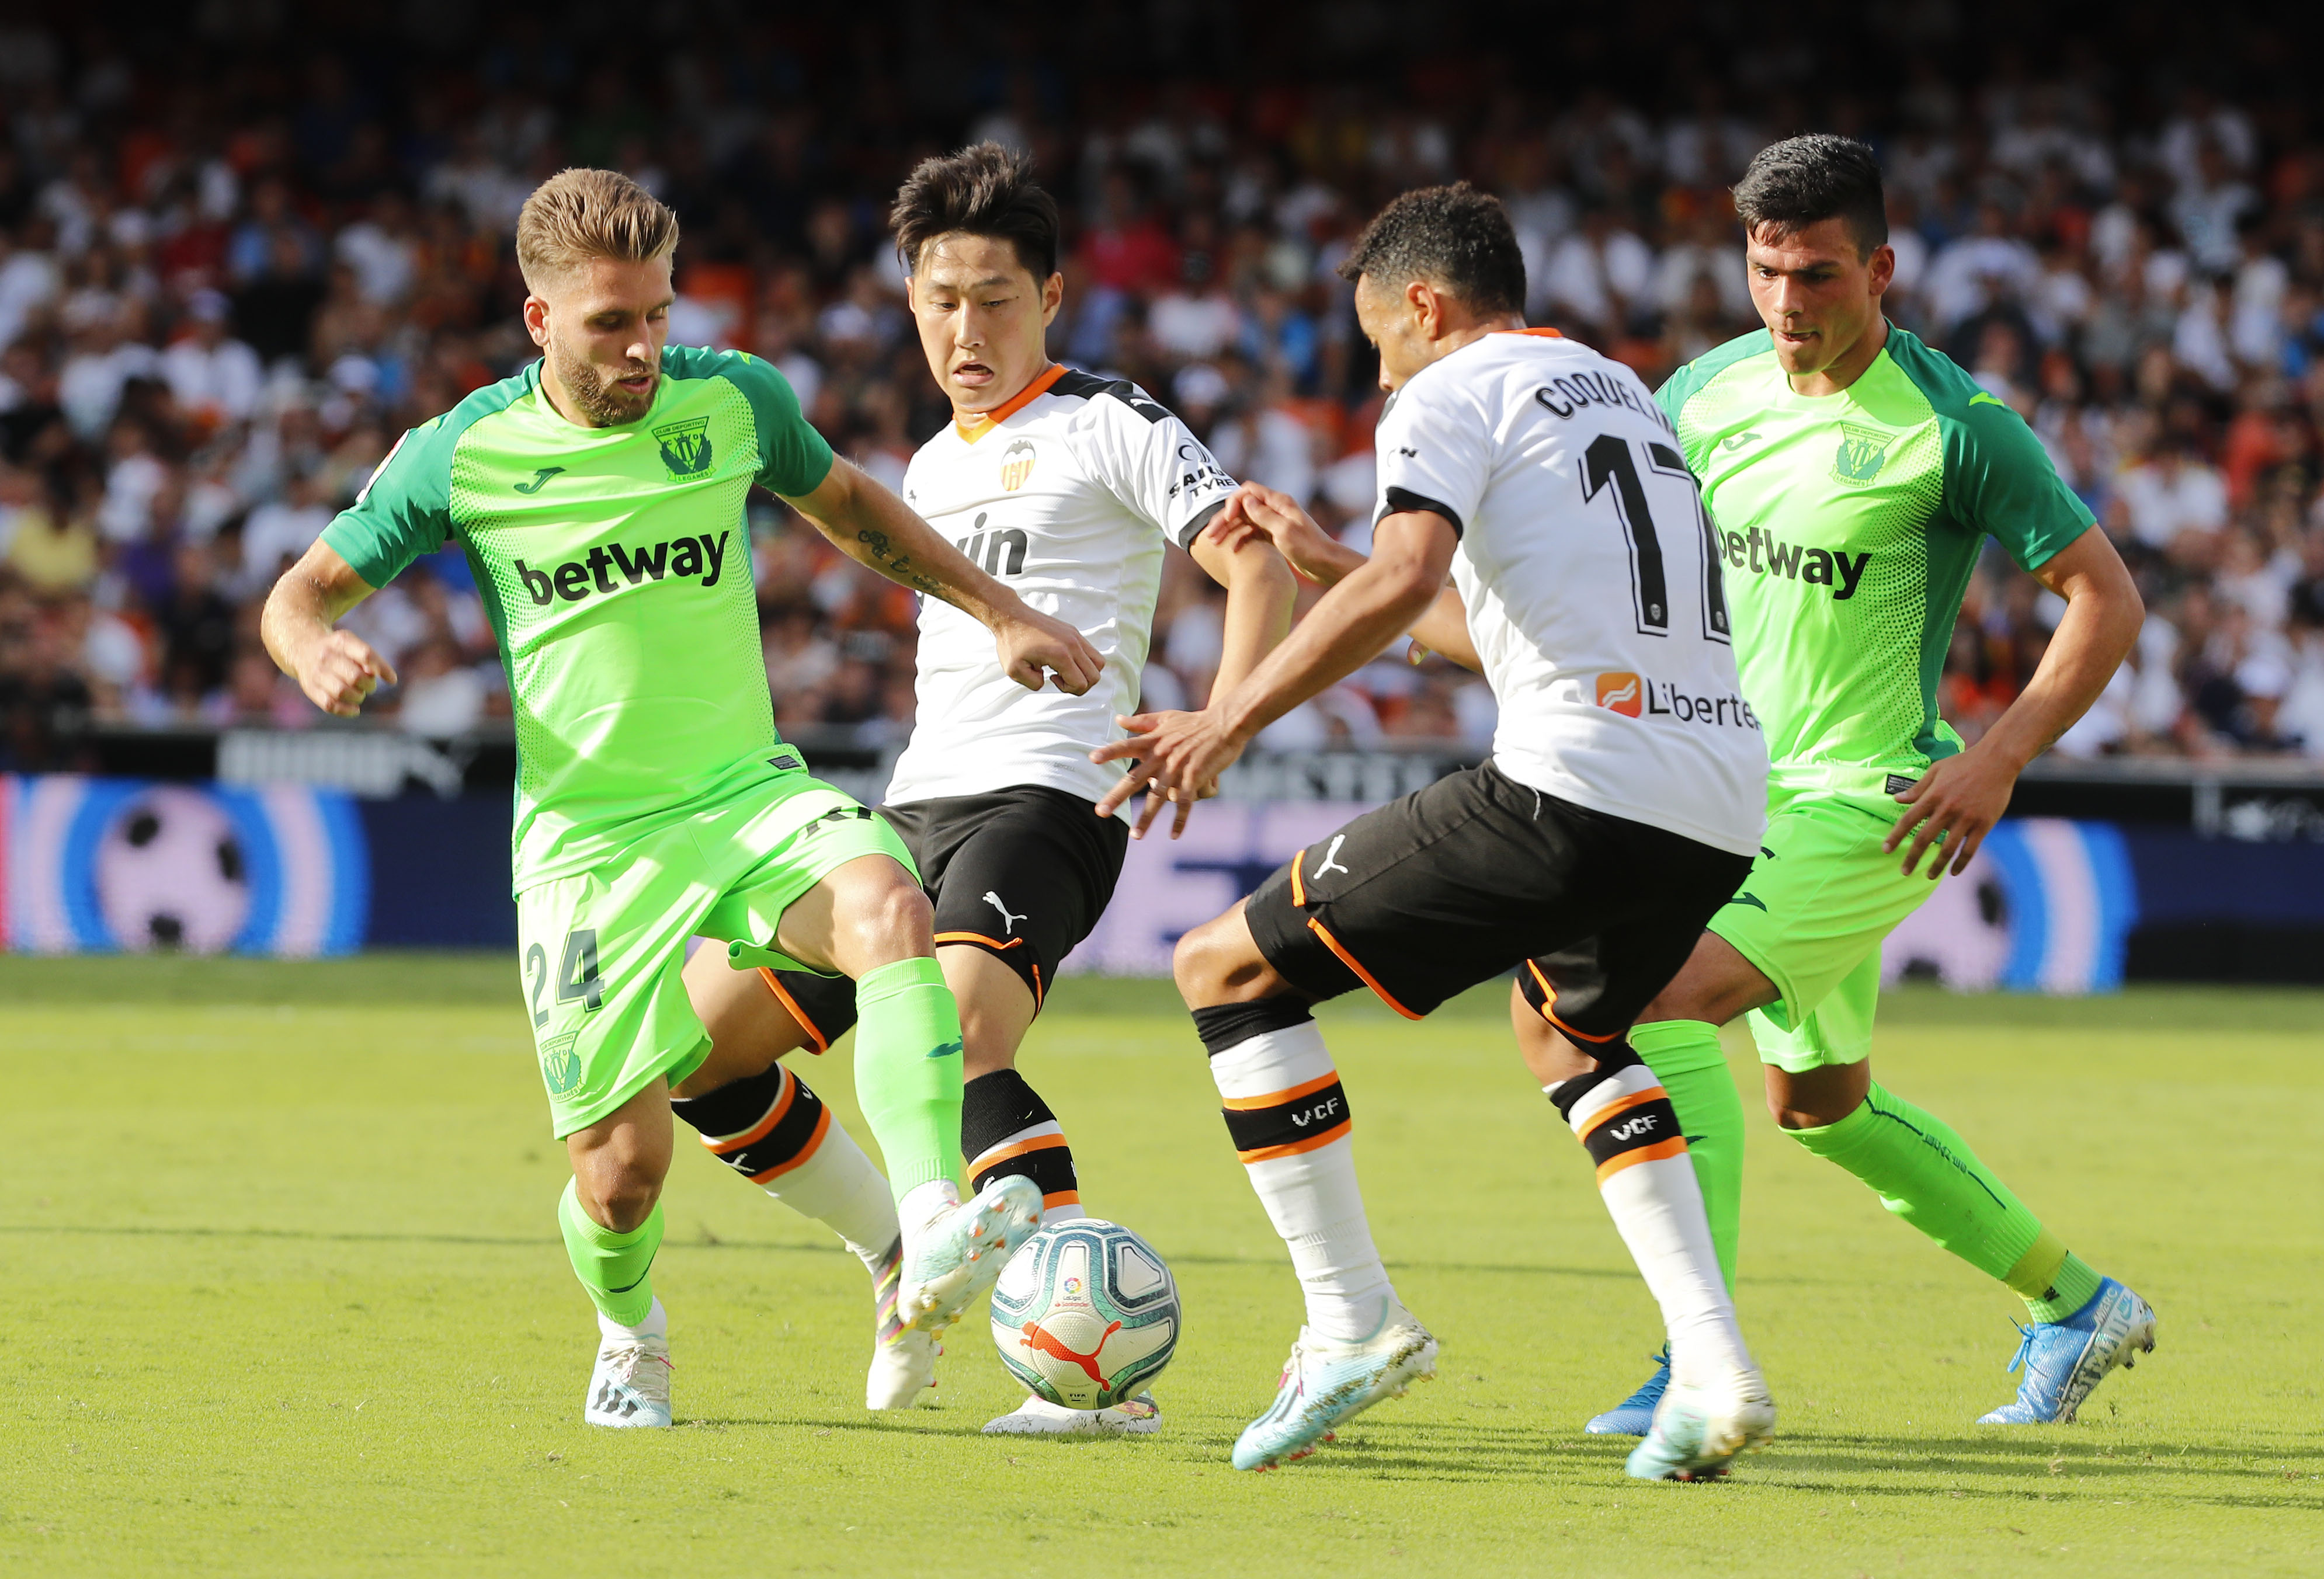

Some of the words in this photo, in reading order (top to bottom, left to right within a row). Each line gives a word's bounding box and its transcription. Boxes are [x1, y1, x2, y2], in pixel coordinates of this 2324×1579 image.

[672, 420, 705, 430] DEPORTIVO
[1860, 429, 1891, 441] DEPORTIVO
[1169, 465, 1227, 499] SAILU
[1578, 434, 1732, 646] 17
[514, 531, 729, 606] betway
[527, 928, 606, 1032] 24
[1291, 1097, 1338, 1127] VCF
[1610, 1115, 1658, 1141] VCF
